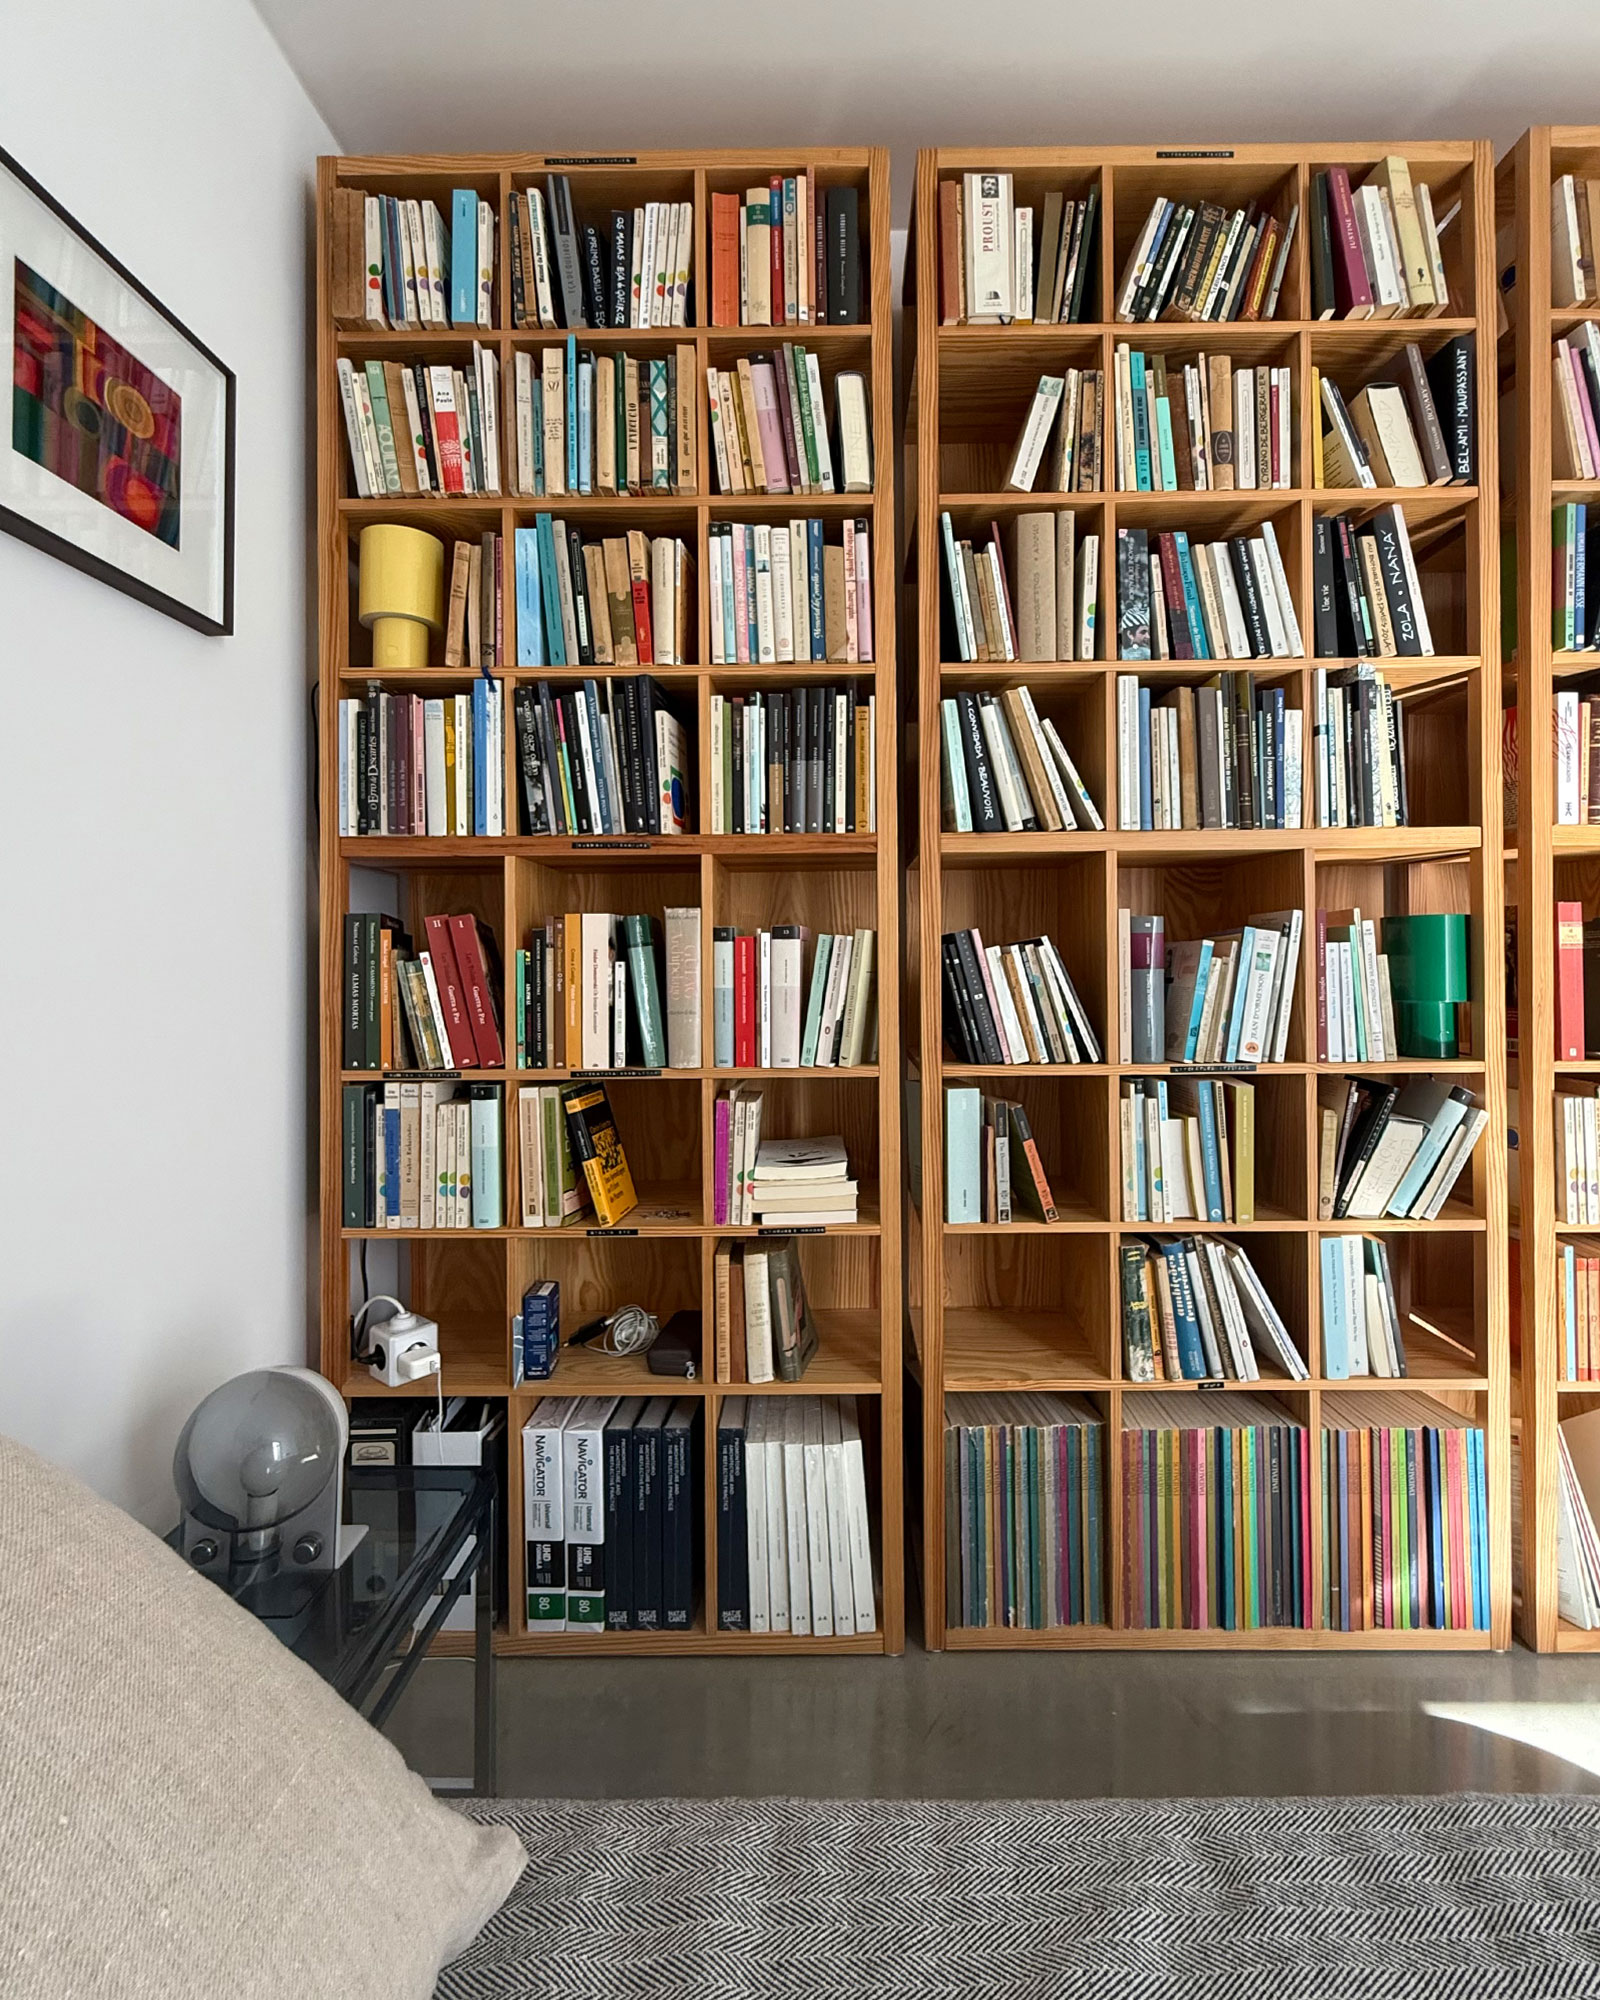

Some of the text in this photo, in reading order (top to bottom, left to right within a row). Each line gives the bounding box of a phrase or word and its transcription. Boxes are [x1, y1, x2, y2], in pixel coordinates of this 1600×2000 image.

[616, 217, 625, 229] OS
[982, 202, 994, 252] PROUST
[1345, 217, 1357, 249] JUSTINE
[588, 236, 599, 265] PRIMO
[616, 232, 626, 260] MAIAS
[1421, 388, 1434, 421] BOVARY
[1259, 390, 1269, 483] CYRANO DE BERGERAC
[1318, 535, 1326, 554] Simone
[747, 566, 755, 593] OWEN
[1179, 551, 1189, 579] Balanço
[1185, 581, 1194, 600] Final
[1575, 553, 1586, 587] HERMANN
[1322, 584, 1331, 612] Une vie
[1383, 533, 1415, 641] ZOLA NANA
[1575, 588, 1586, 609] HESSE
[966, 699, 994, 820] A CONVIDADA BEAUVOIR
[669, 932, 683, 1001] Archipelago
[683, 944, 696, 1000] GULAG
[447, 985, 460, 1024] Guerra Paz
[472, 985, 486, 1025] Guerra Paz
[1250, 1021, 1259, 1040] JEAN
[1167, 1254, 1185, 1317] ambições
[1177, 1252, 1196, 1322] frustradas
[535, 1434, 547, 1497] NAVIGATOR
[577, 1438, 588, 1500] NAVIGATOR
[544, 1503, 552, 1530] Universal
[585, 1505, 593, 1532] Universal
[542, 1544, 551, 1562] UHD
[583, 1546, 592, 1565] UHD
[538, 1596, 549, 1610] 80
[579, 1599, 589, 1613] 80
